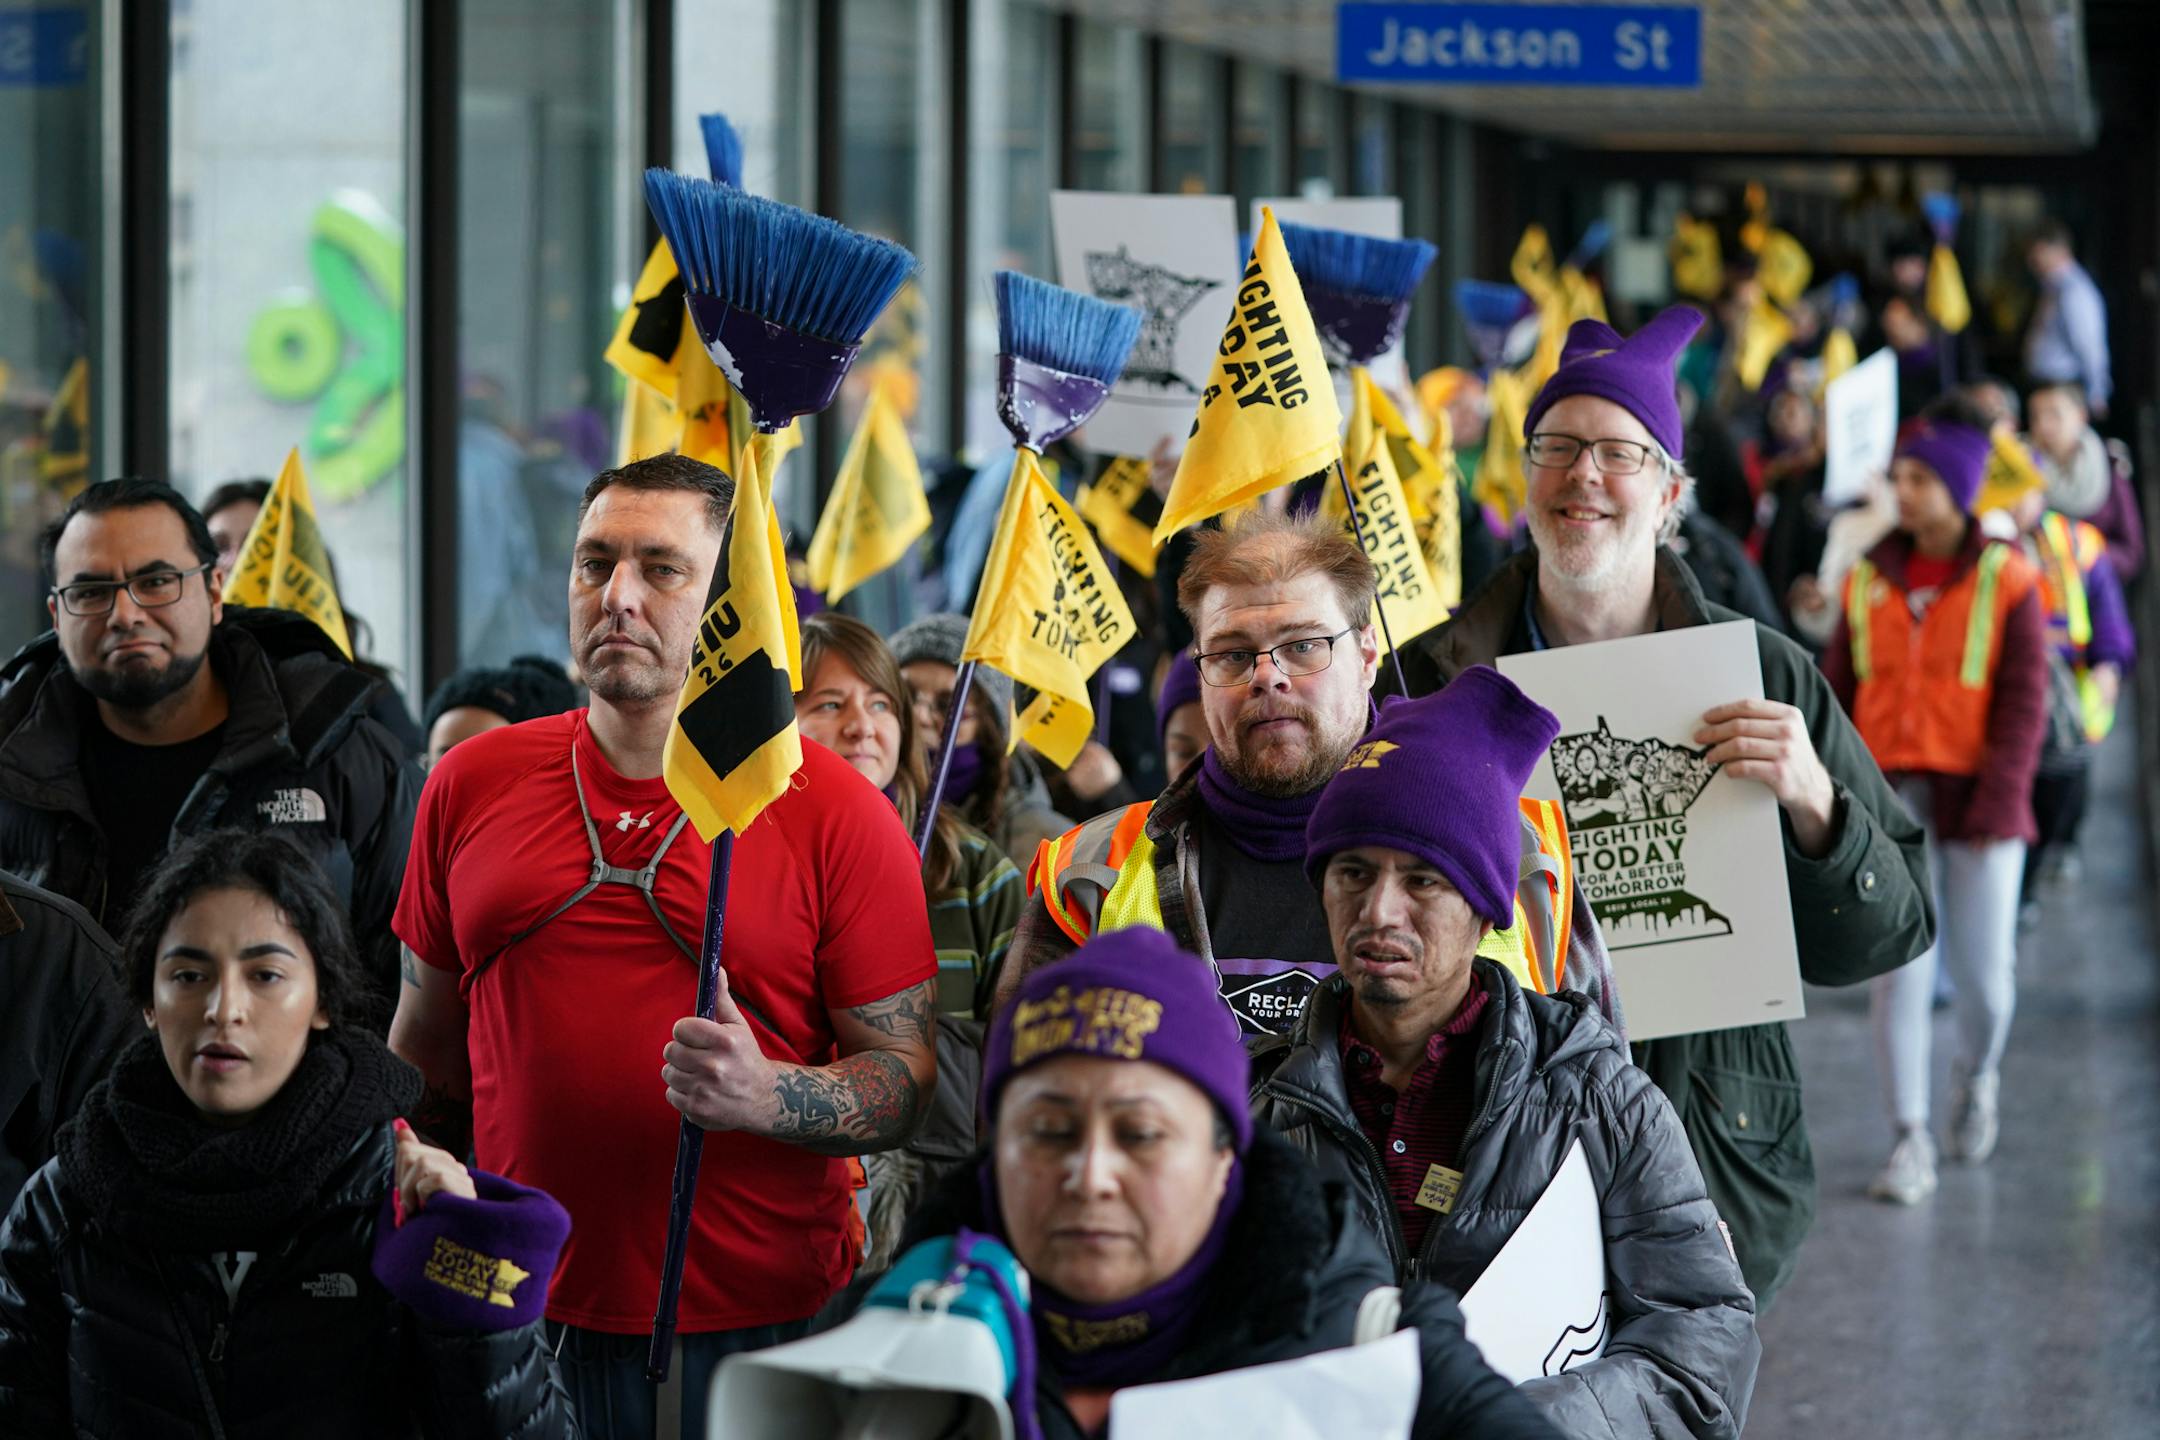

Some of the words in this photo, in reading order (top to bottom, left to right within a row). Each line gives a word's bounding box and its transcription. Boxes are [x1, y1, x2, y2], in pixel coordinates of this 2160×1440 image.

[1367, 17, 1581, 68] Jackson
[1614, 20, 1672, 70] St
[1236, 249, 1309, 410] IGHTING
[698, 652, 733, 686] 26
[257, 800, 304, 814] NORTH
[274, 788, 301, 801] THE
[272, 811, 305, 824] FACE
[1570, 818, 1687, 850] FIGHTING
[1572, 838, 1684, 874] TODAY
[1578, 871, 1608, 886] FOR
[1614, 870, 1623, 881] A
[1629, 861, 1685, 879] BETTER
[1582, 874, 1686, 899] TOMORROW
[1631, 899, 1659, 910] LOCAL
[1251, 1008, 1281, 1019] YOUR
[432, 1246, 494, 1281] TODAY
